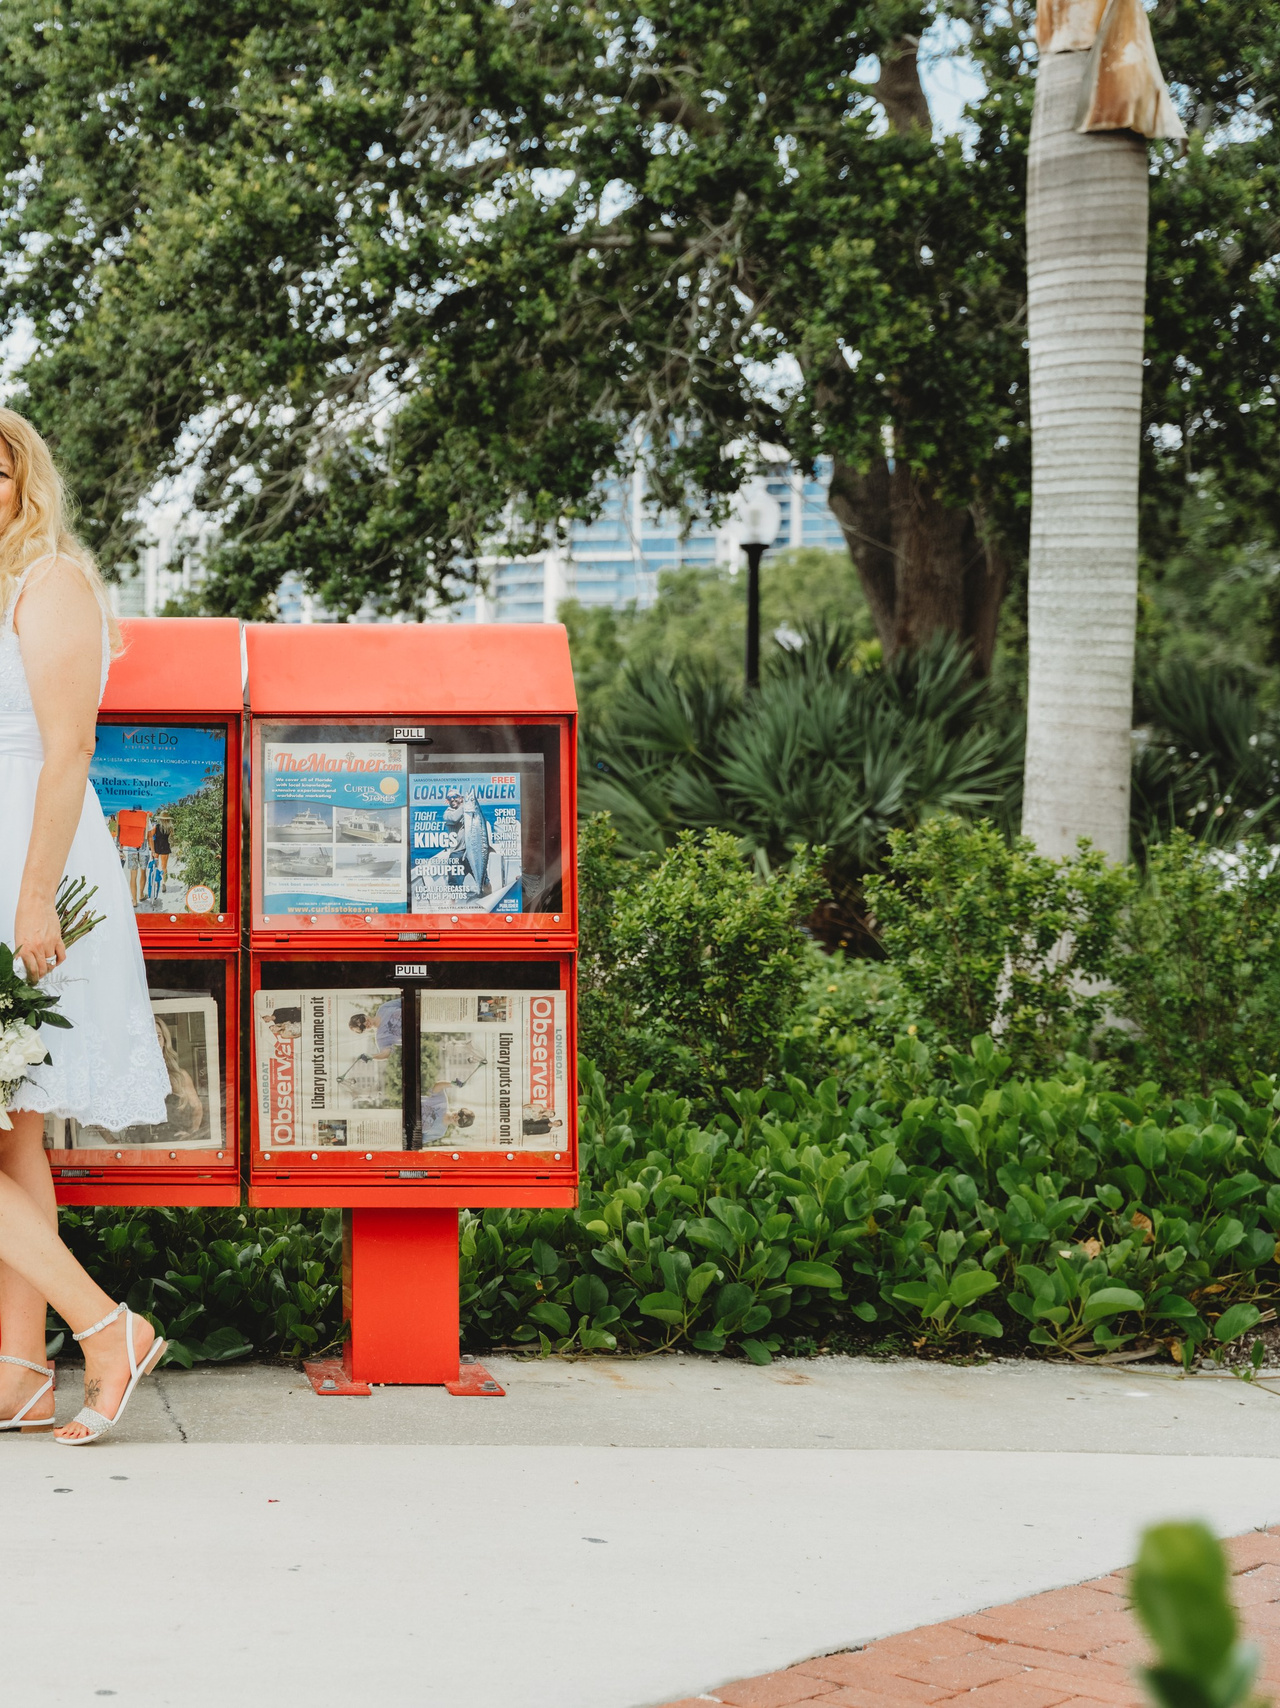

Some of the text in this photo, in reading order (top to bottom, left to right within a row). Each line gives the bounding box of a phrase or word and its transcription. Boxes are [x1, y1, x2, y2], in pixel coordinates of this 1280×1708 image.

[122, 731, 178, 745] Must Do
[395, 729, 424, 738] PULL
[102, 777, 130, 786] Relax.
[132, 778, 172, 788] Explore.
[104, 788, 153, 796] Memories.
[414, 811, 437, 820] TIGHT
[414, 822, 446, 831] BUDGET
[414, 832, 458, 848] KINGS
[416, 865, 465, 876] GROUPER
[192, 892, 208, 901] BIG
[397, 966, 424, 975] PULL
[314, 1005, 324, 1016] on
[314, 1019, 324, 1045] name
[497, 1032, 513, 1065] Library
[532, 998, 552, 1108] Observer
[312, 1054, 327, 1075] puts
[497, 1066, 512, 1087] puts
[311, 1076, 327, 1109] Library
[500, 1097, 510, 1123] name
[500, 1125, 510, 1137] on
